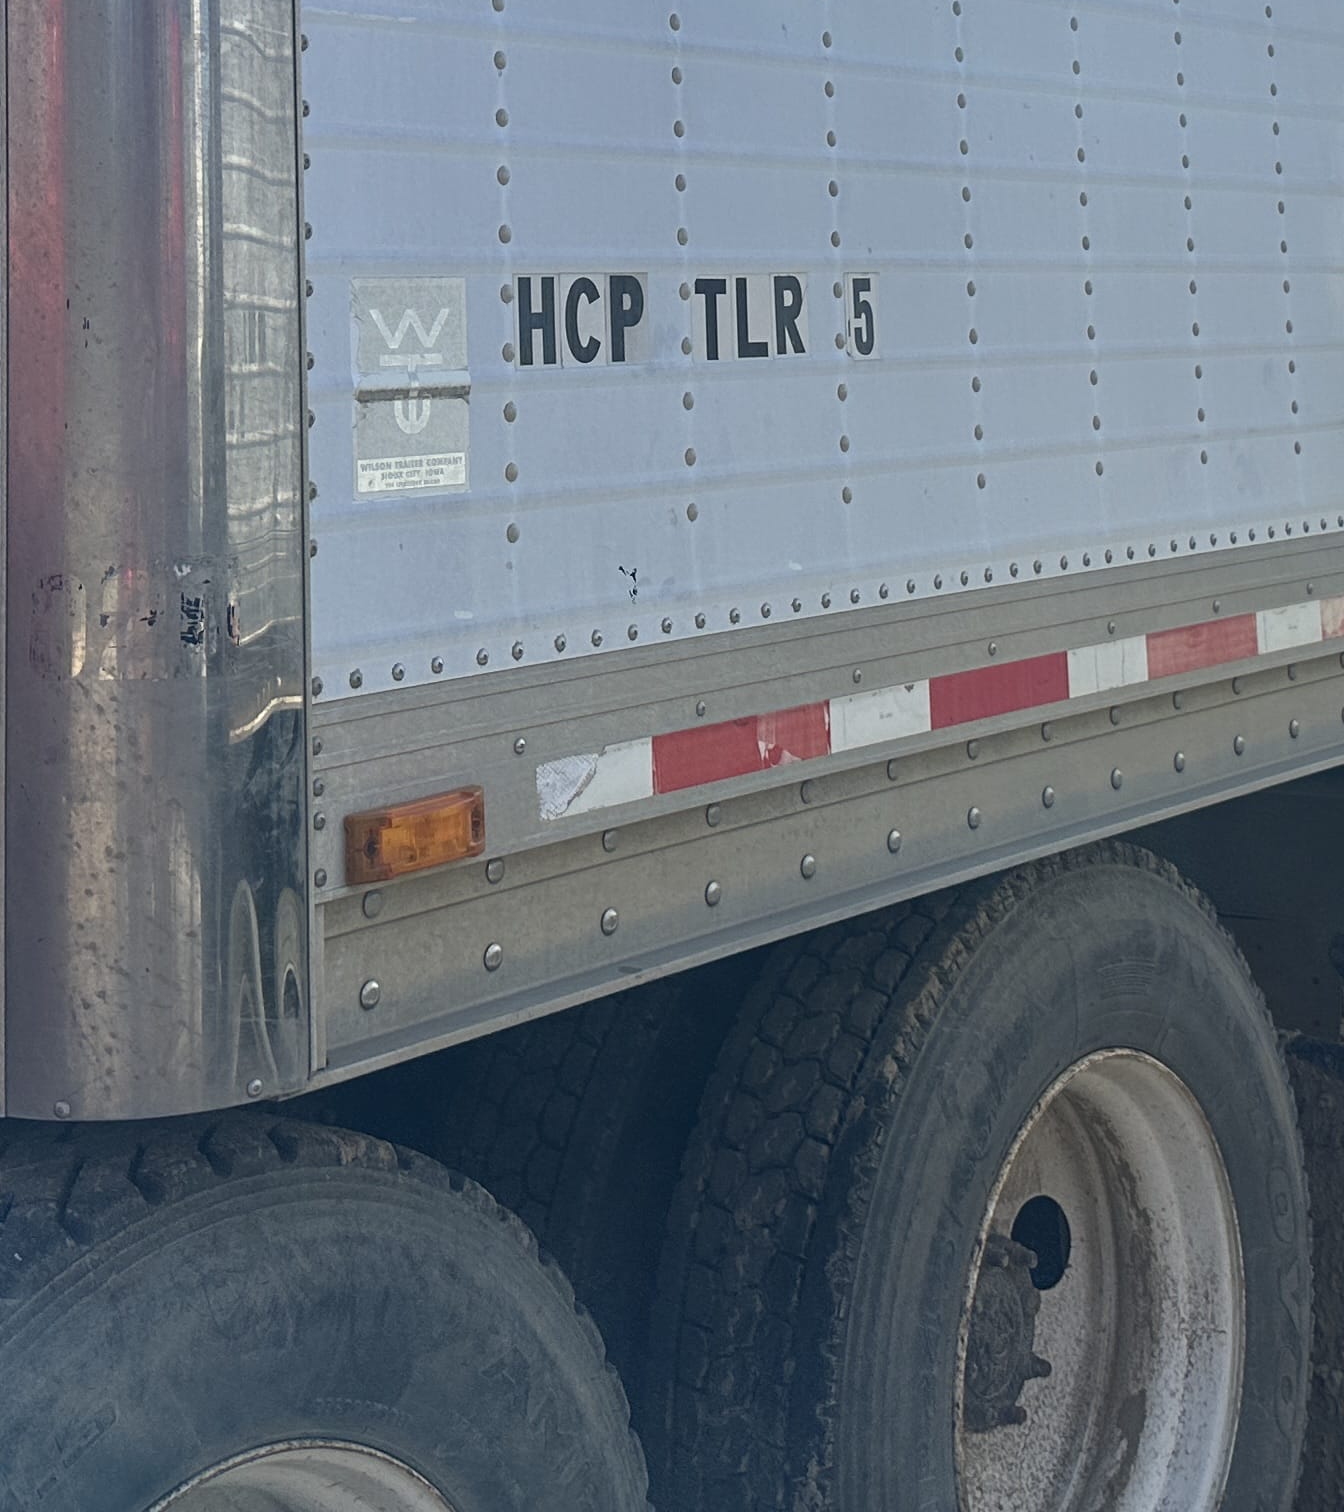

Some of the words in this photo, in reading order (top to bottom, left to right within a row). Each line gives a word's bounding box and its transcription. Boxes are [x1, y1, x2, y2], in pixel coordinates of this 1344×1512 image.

[369, 307, 450, 349] W
[517, 274, 645, 367] HCP
[694, 274, 806, 361] TLR
[850, 277, 877, 357] 5
[360, 462, 392, 472] WILSON
